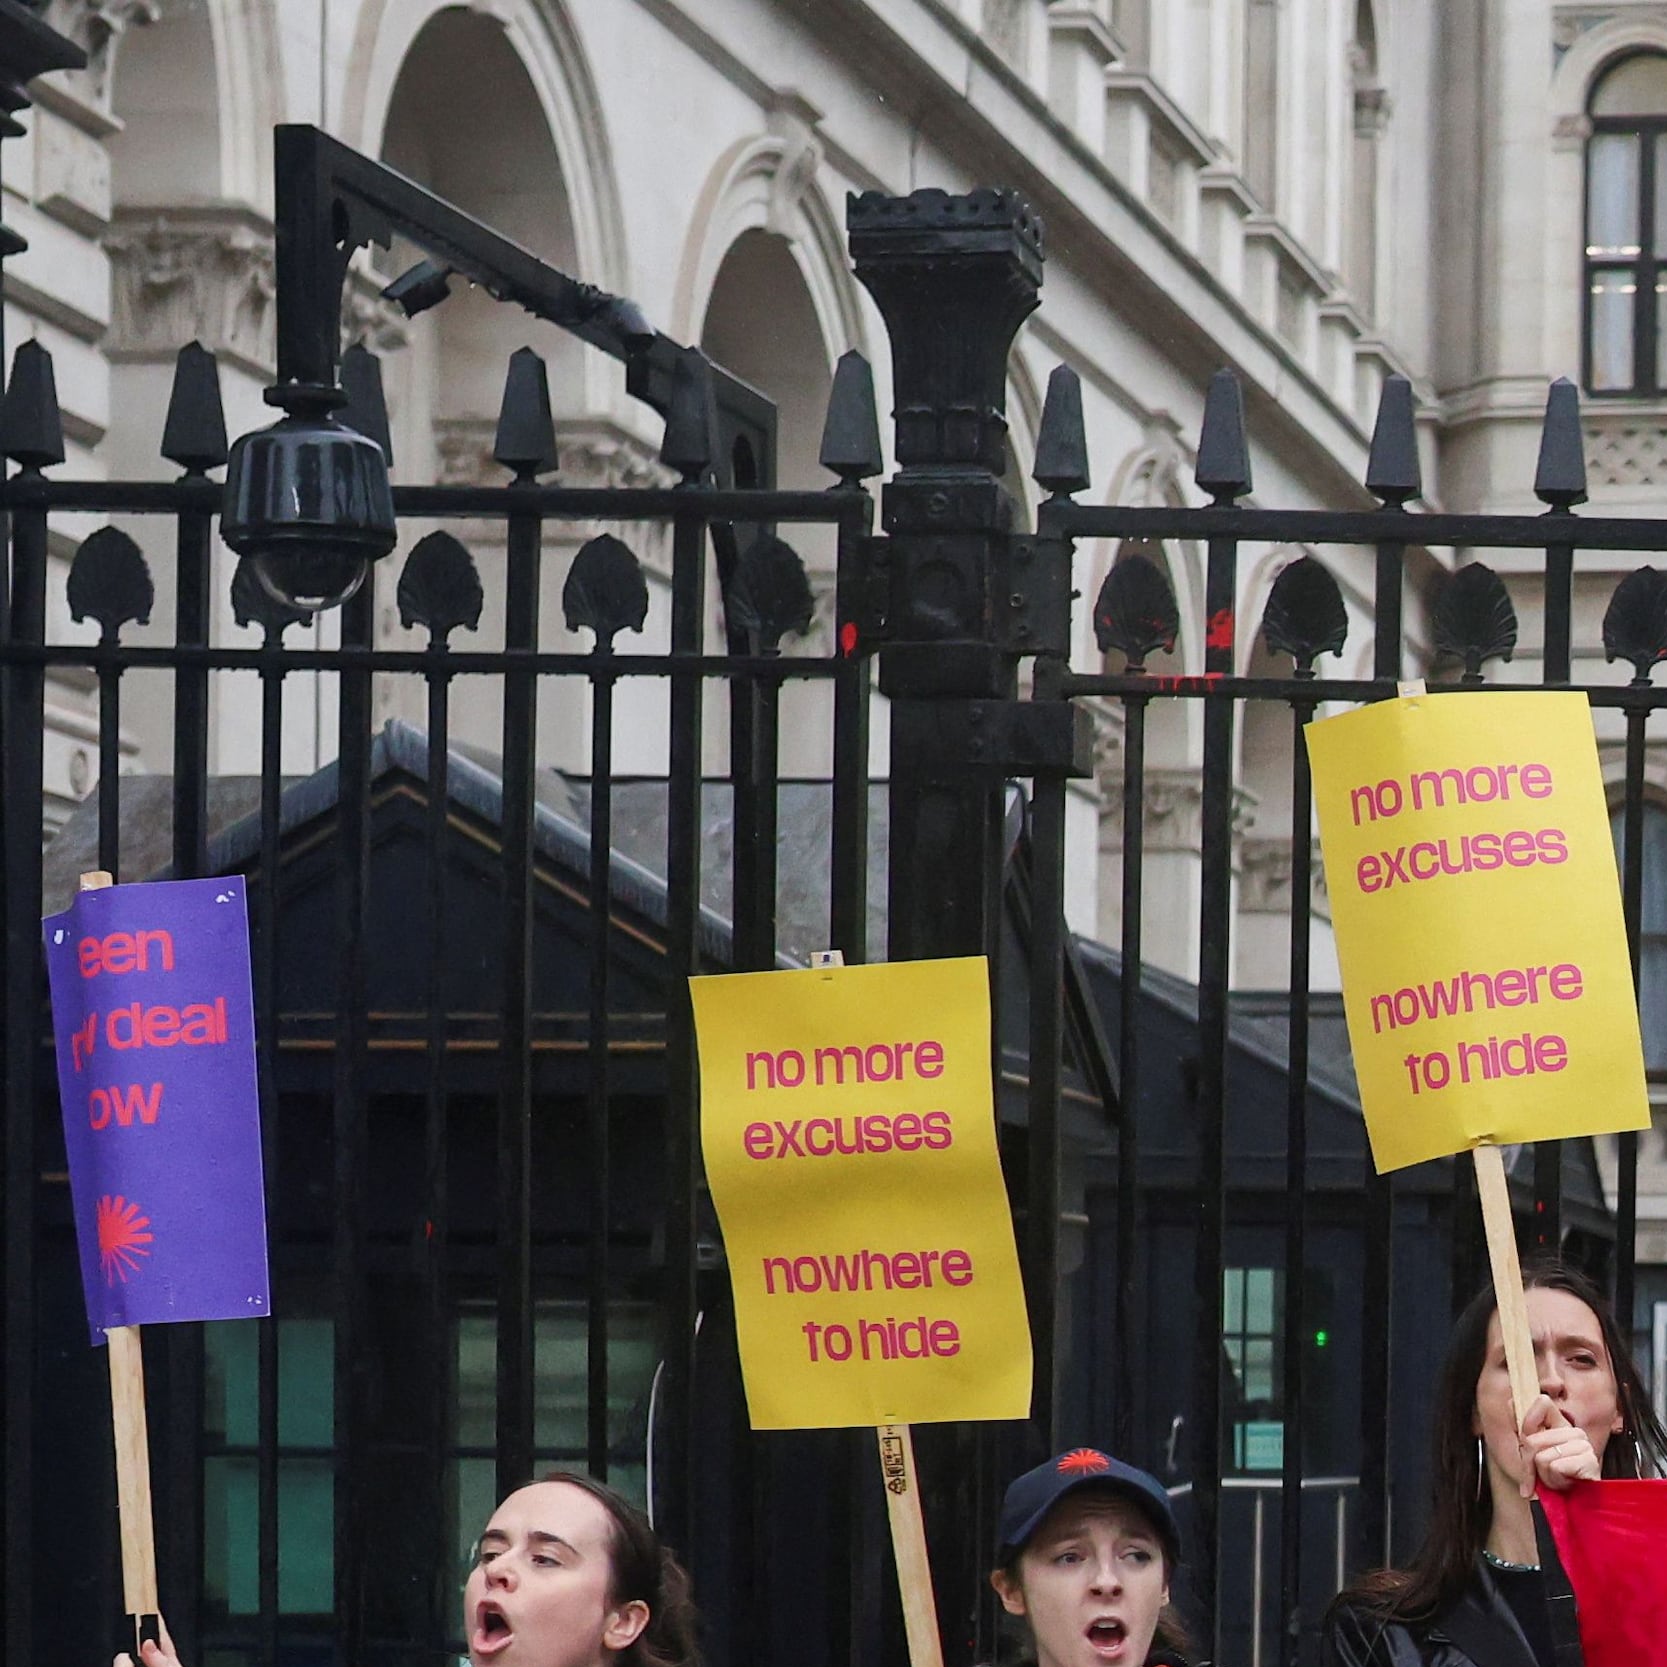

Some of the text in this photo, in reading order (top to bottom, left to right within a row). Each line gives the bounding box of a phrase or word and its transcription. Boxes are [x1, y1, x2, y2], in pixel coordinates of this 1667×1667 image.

[1351, 763, 1553, 823] no more
[1357, 828, 1569, 893] excuses
[78, 929, 175, 979] een
[1371, 963, 1584, 1031] nowhere
[106, 996, 229, 1050] deal
[747, 1040, 944, 1089] no more
[1405, 1033, 1568, 1093] to hide
[89, 1082, 164, 1131] ow
[744, 1111, 953, 1160] excuses
[764, 1249, 973, 1294] nowhere
[801, 1316, 960, 1361] to hide
